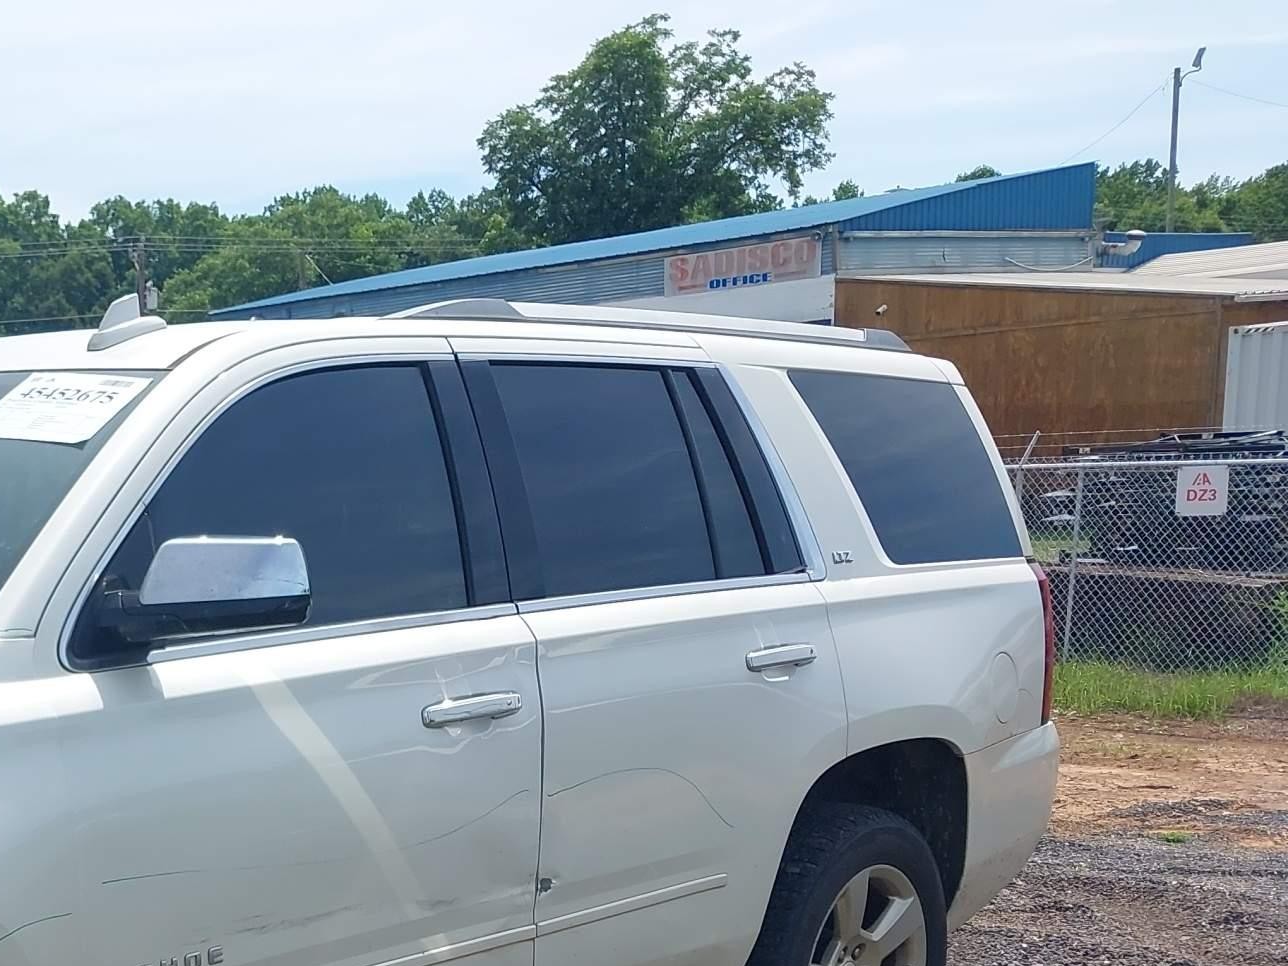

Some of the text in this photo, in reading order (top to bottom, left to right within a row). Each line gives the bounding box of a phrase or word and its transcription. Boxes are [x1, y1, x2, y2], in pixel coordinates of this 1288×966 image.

[669, 240, 817, 282] SADISCO
[708, 272, 773, 289] OFFICE
[20, 387, 120, 404] 45452675
[1186, 488, 1217, 502] DZ3
